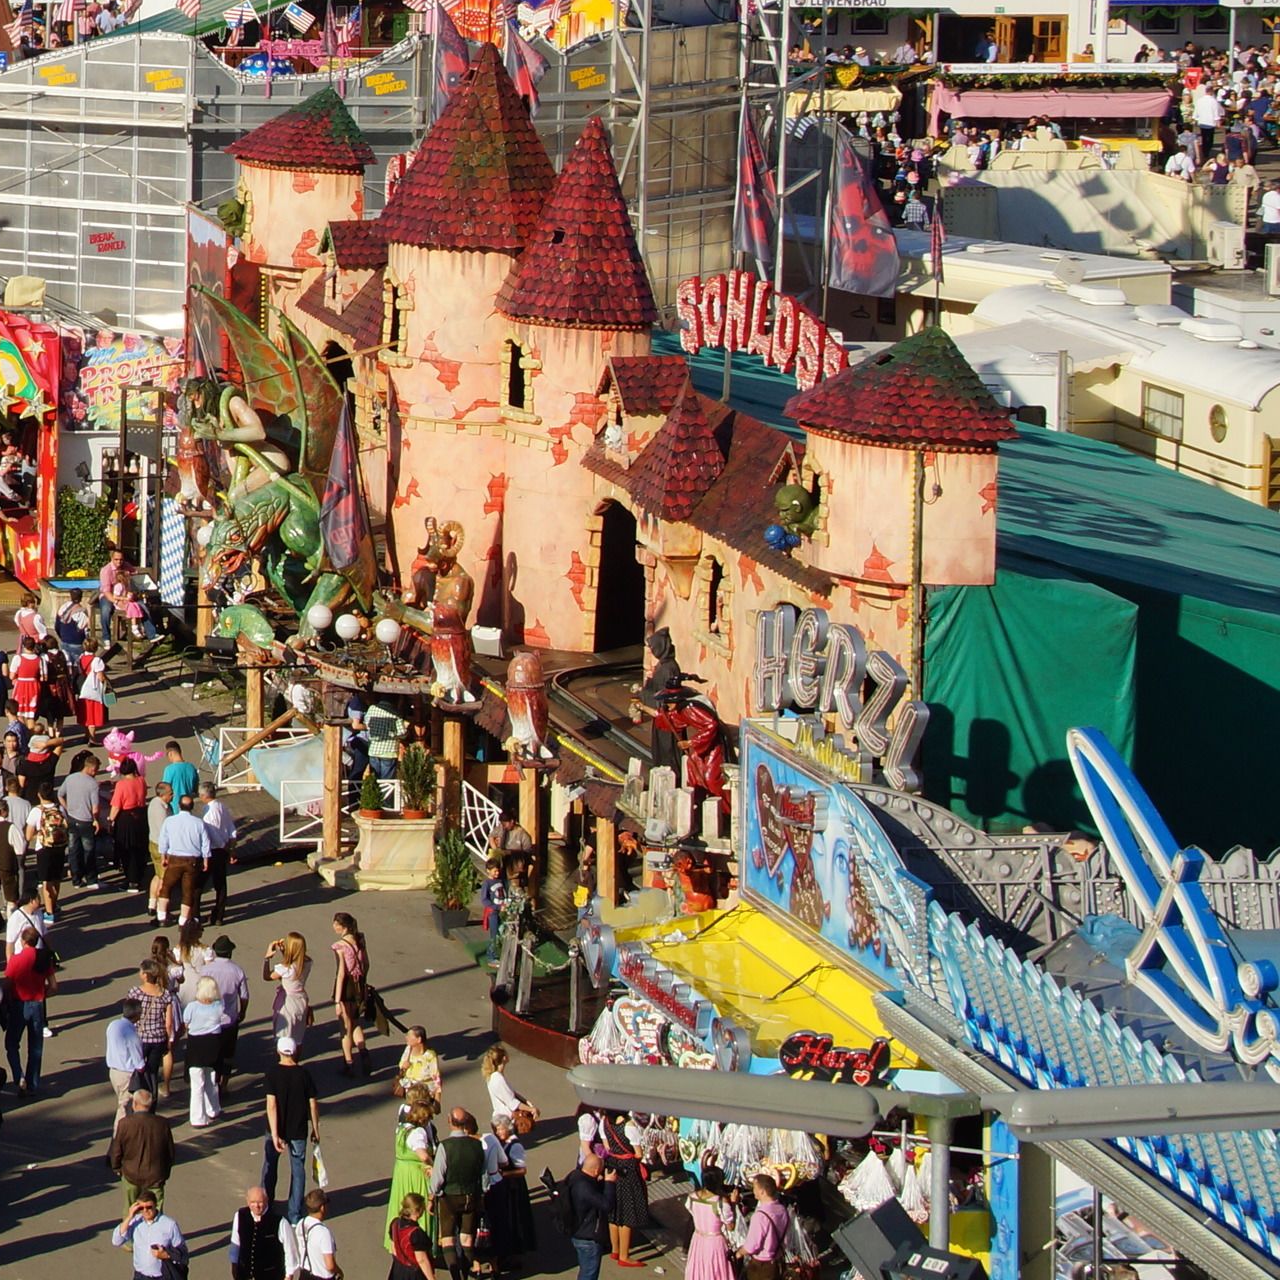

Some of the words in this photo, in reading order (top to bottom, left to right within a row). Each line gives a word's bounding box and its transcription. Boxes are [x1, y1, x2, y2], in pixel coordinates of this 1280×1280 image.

[88, 232, 116, 247] BREAK
[96, 240, 127, 254] DANCER
[754, 604, 930, 793] HERZL
